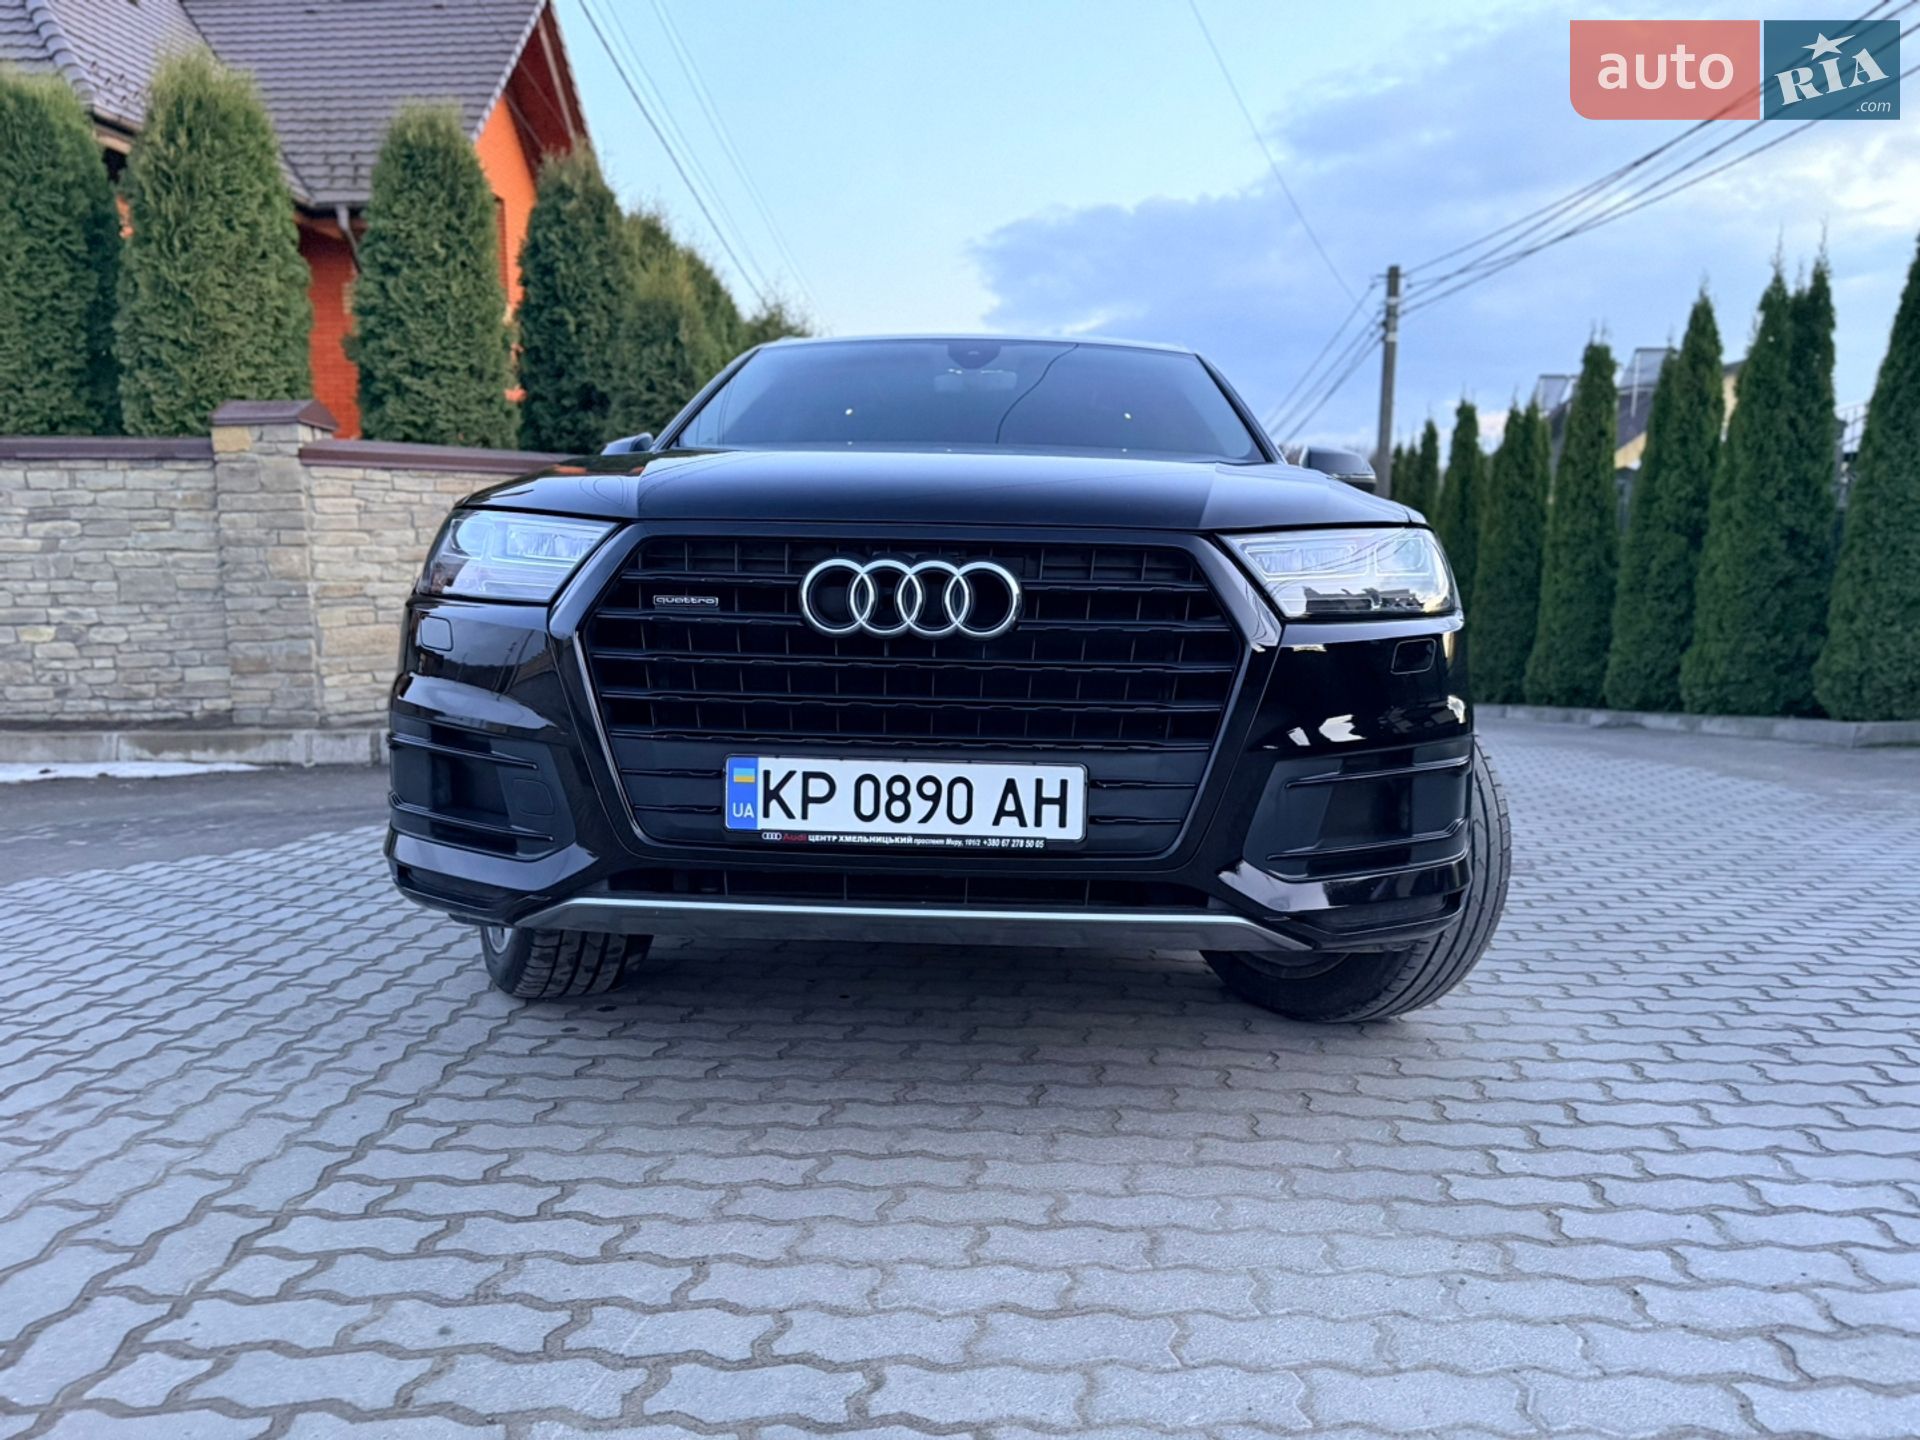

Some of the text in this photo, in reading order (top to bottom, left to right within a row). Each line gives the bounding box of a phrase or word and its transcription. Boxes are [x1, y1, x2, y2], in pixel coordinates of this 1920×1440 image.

[762, 769, 1069, 828] KP 0890 AH
[733, 802, 755, 819] UA
[783, 833, 807, 842] Audi
[808, 835, 837, 843] ЦЕНТР
[838, 834, 913, 845] ХМЕЛЬНИЦЬКИЙ
